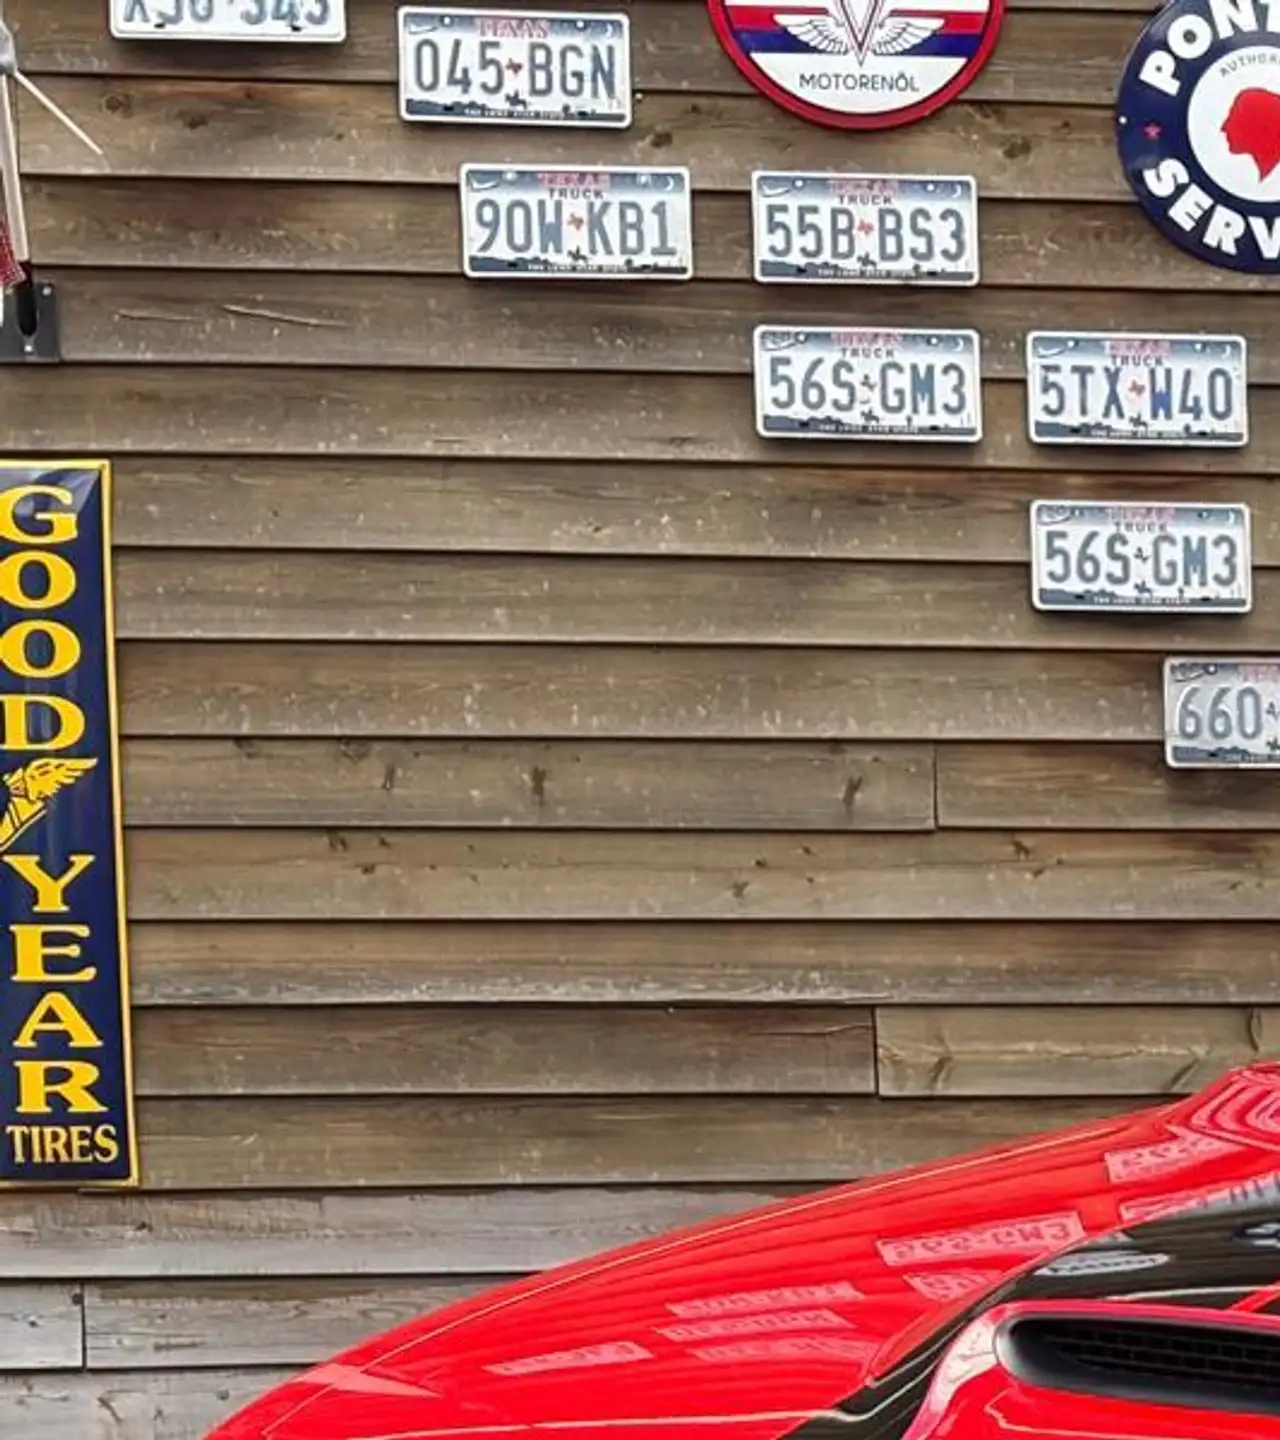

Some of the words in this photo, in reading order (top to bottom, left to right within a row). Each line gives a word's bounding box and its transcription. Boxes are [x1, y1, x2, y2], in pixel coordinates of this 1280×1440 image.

[529, 41, 616, 100] BGN
[549, 187, 604, 200] TRUCK
[837, 194, 893, 206] TRUCK
[588, 200, 678, 256] KB1
[766, 203, 855, 260] 55B
[878, 207, 966, 262] BS3
[841, 347, 895, 359] TRUCK
[1111, 354, 1164, 367] TRUCK
[770, 357, 856, 412] 56S
[880, 361, 966, 415] GM3
[1041, 365, 1124, 419] 5TX
[1045, 530, 1131, 585] 56S
[1153, 533, 1237, 587] GM3
[6, 1124, 119, 1164] TIRES
